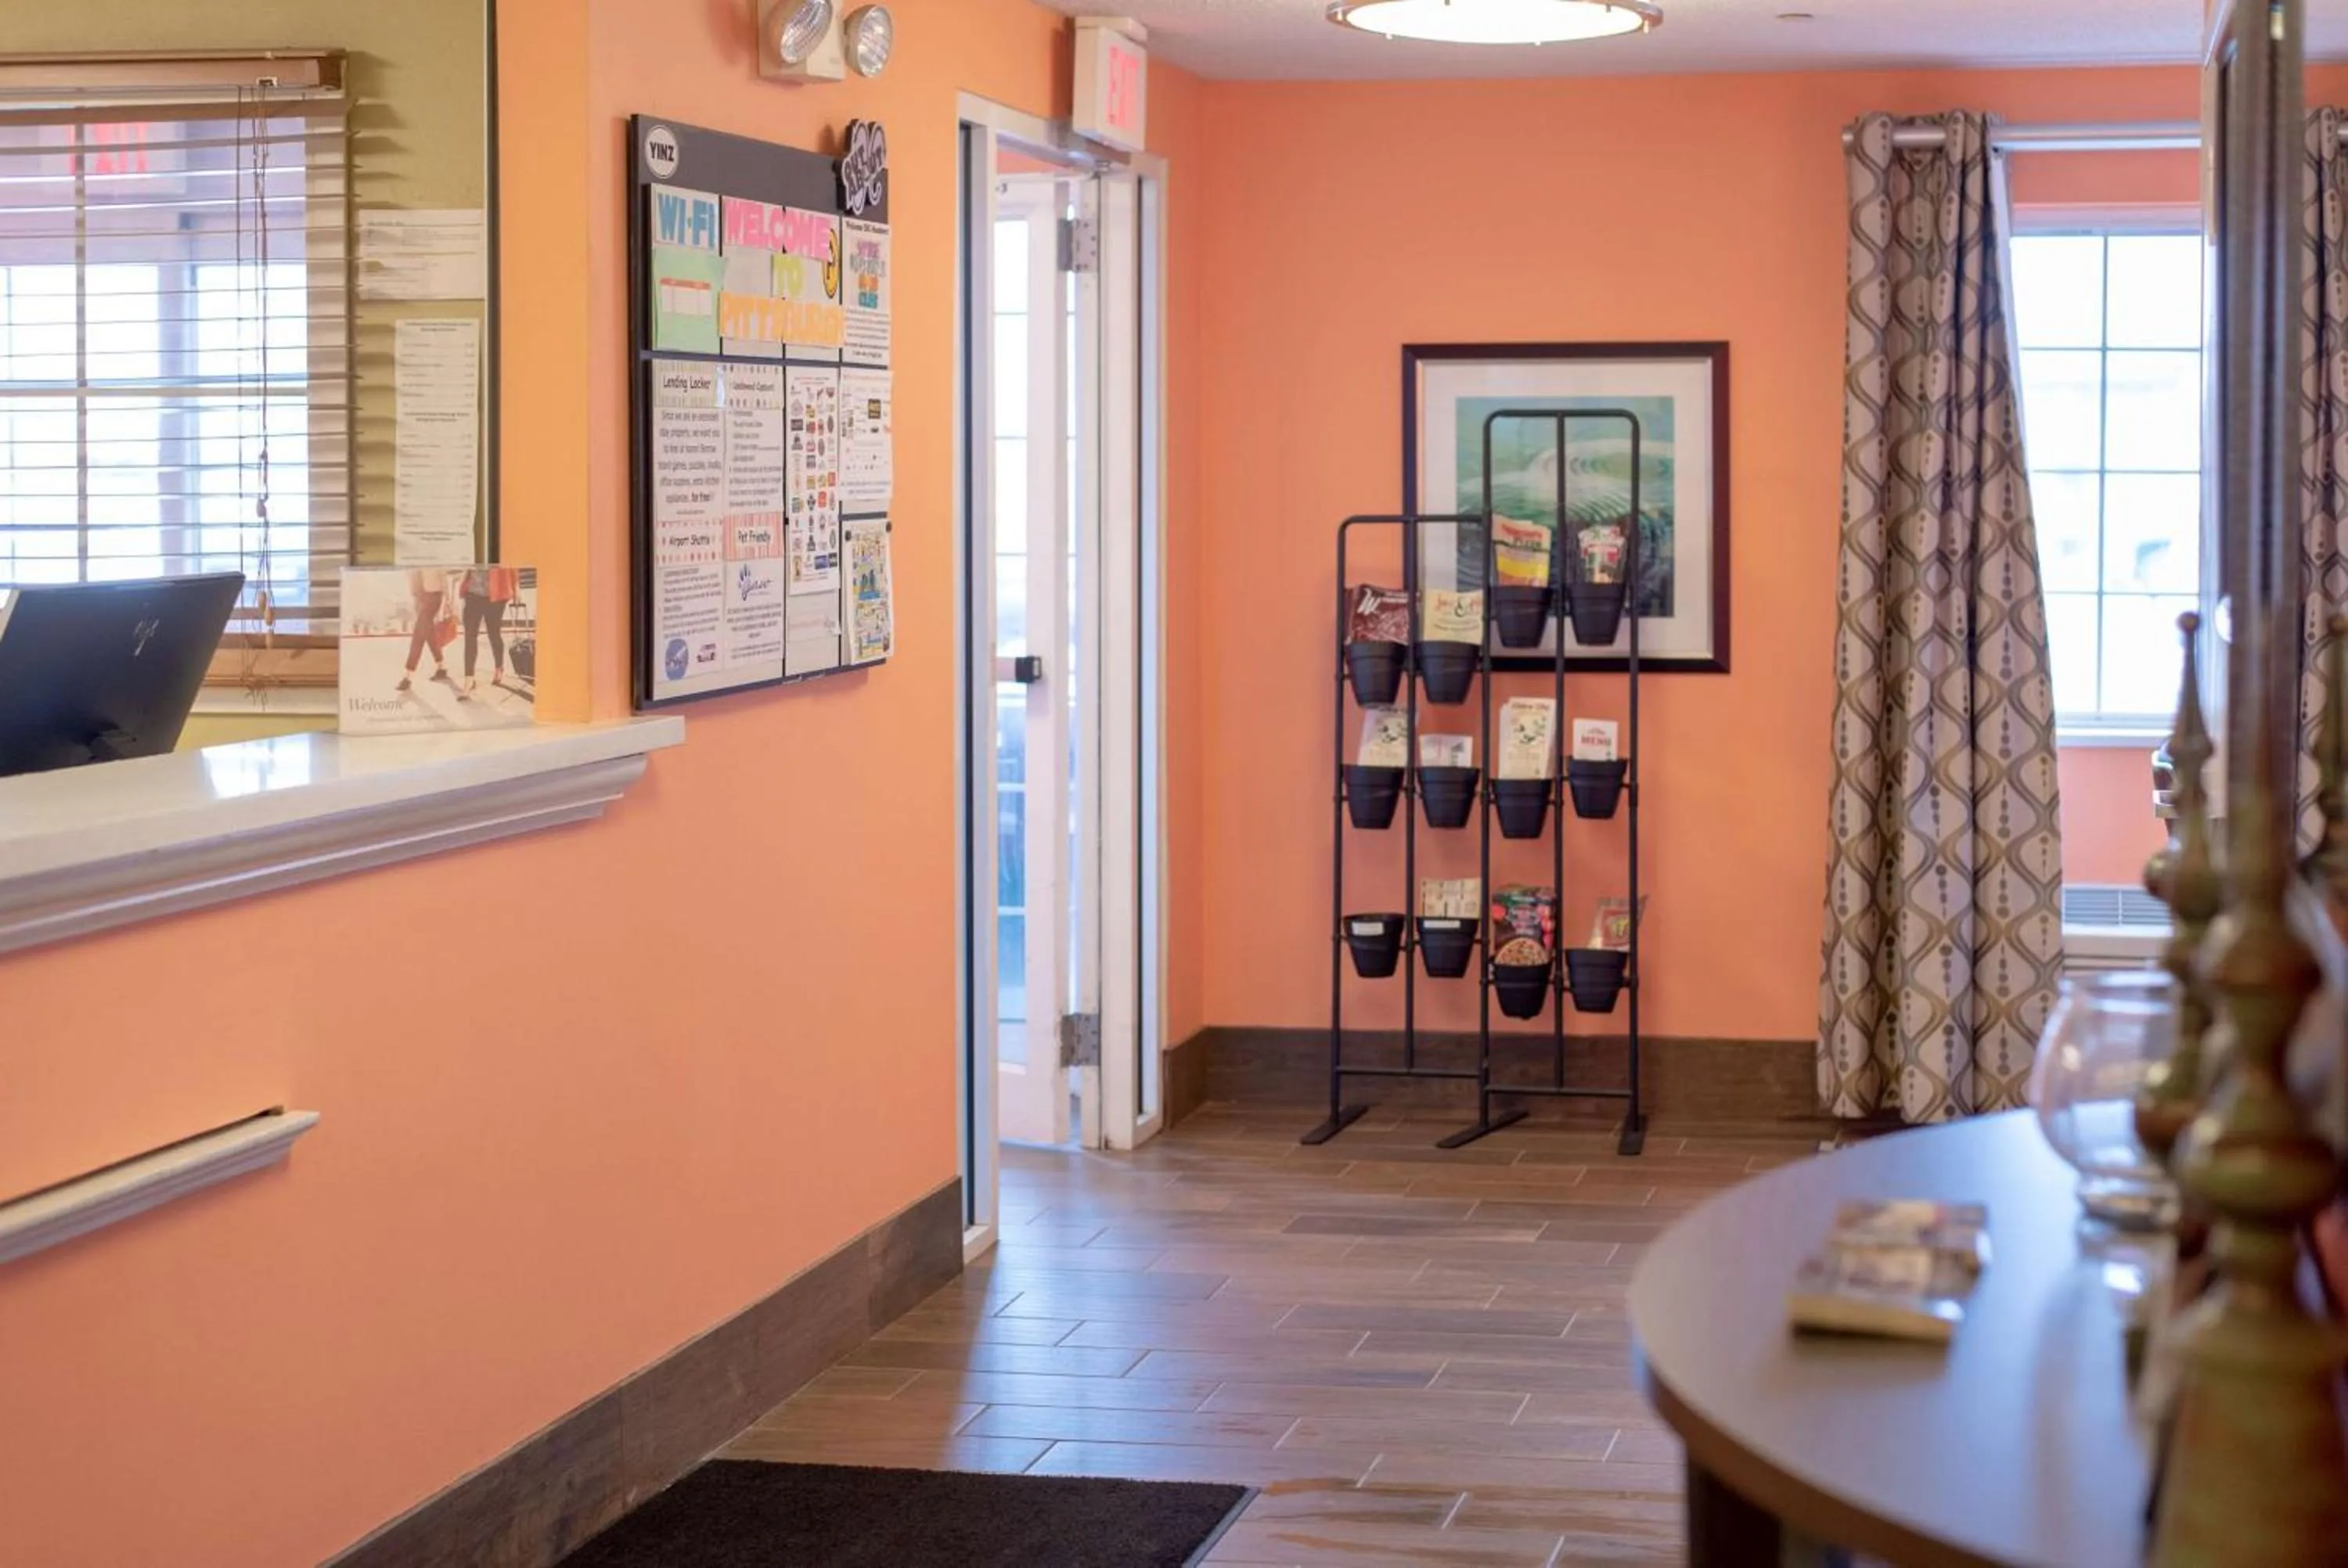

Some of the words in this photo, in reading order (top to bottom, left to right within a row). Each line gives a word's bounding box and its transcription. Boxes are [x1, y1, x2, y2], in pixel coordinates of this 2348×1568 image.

[649, 142, 675, 162] YINZ
[723, 200, 831, 262] WELCOME
[772, 255, 804, 297] TO
[663, 376, 687, 393] Lending
[690, 376, 711, 389] Locker
[738, 530, 747, 543] Pet
